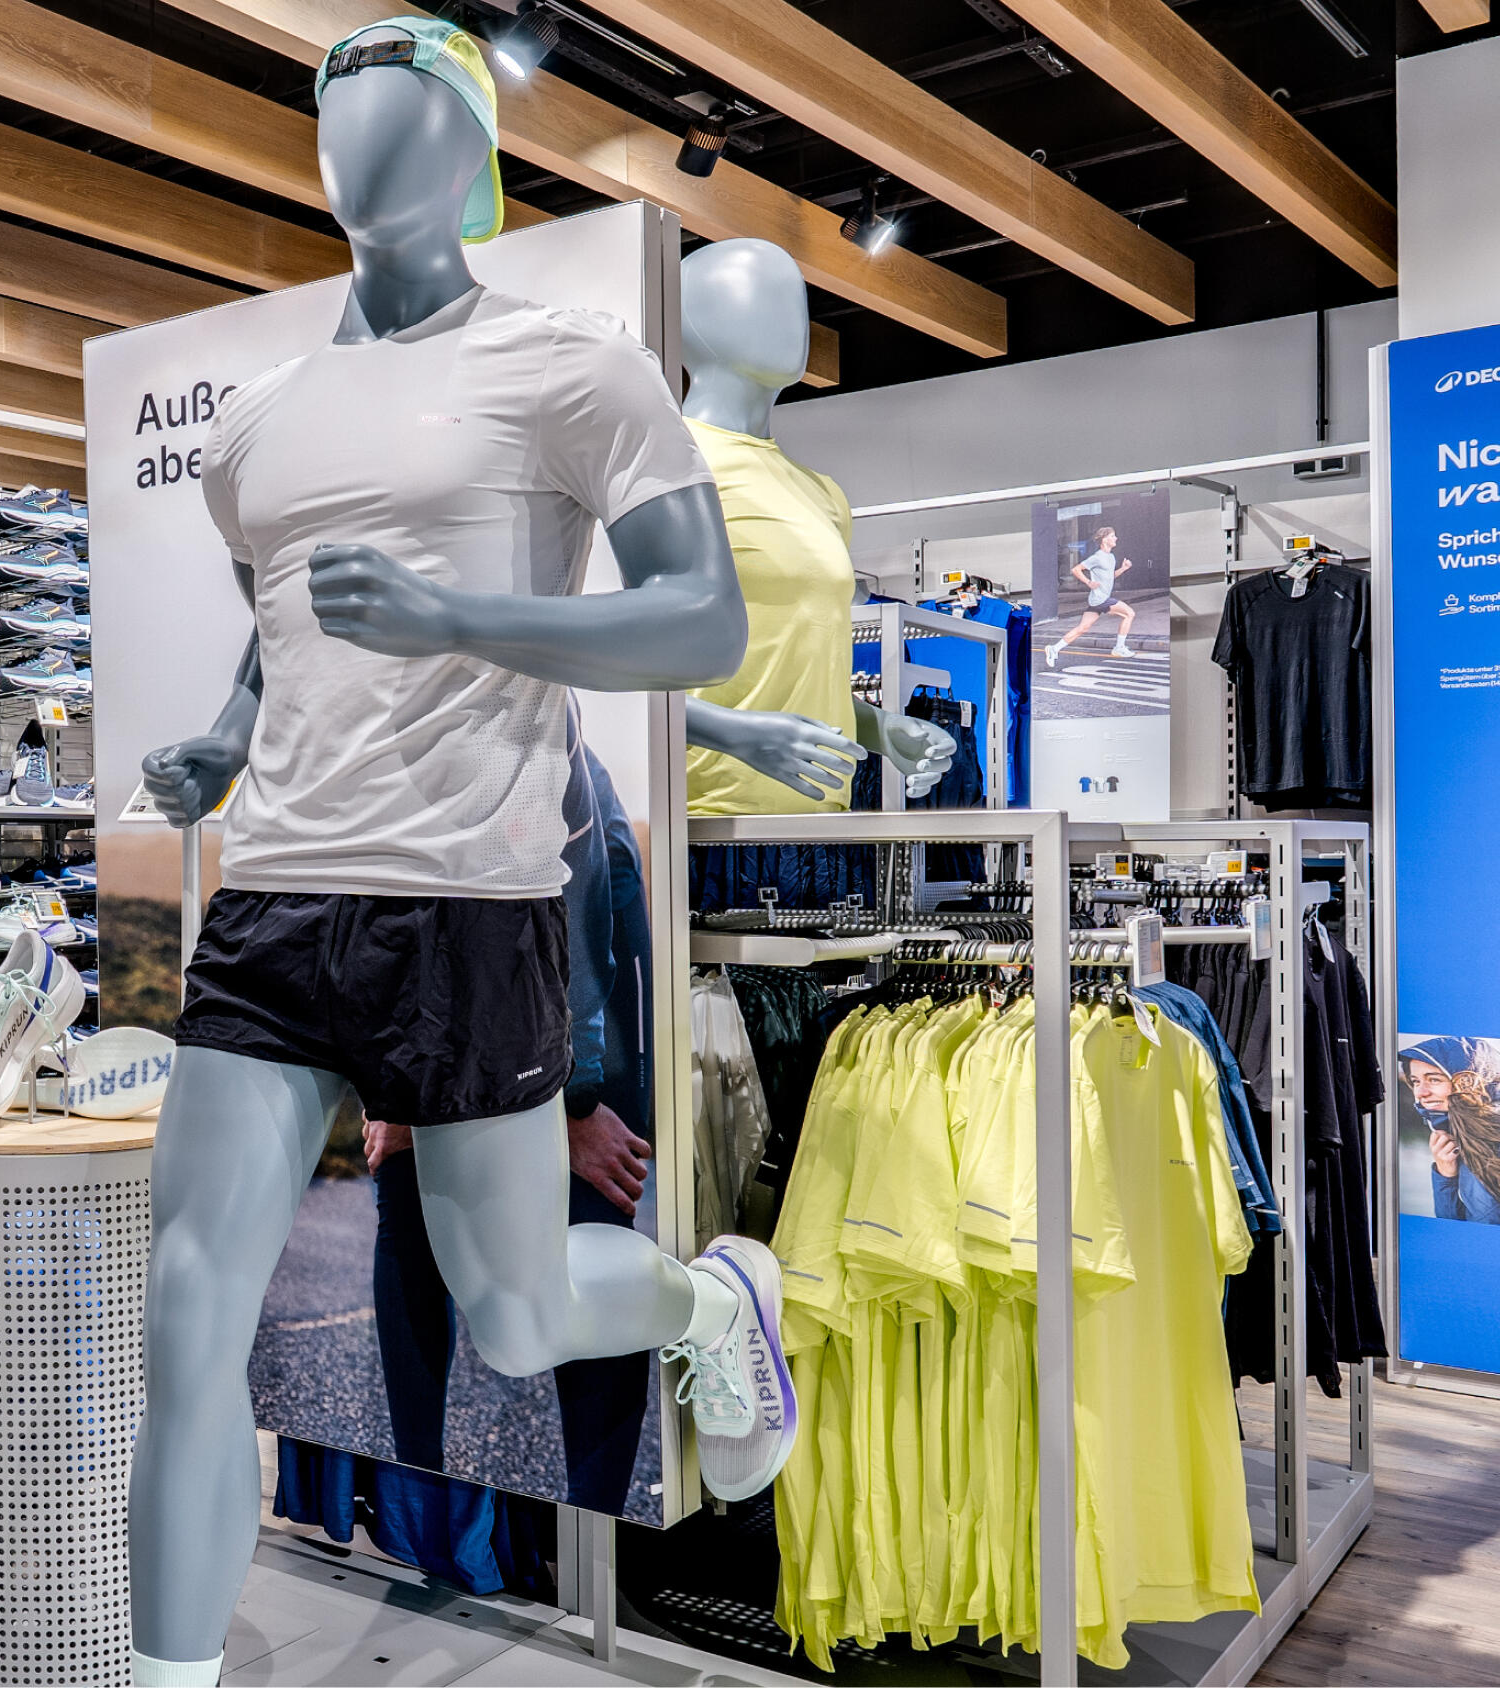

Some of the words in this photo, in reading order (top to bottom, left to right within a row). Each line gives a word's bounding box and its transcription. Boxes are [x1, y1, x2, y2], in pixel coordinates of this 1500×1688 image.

[59, 1052, 172, 1107] KIPRUN
[516, 1065, 543, 1081] KIPRUN
[746, 1328, 782, 1431] KIPRUN
